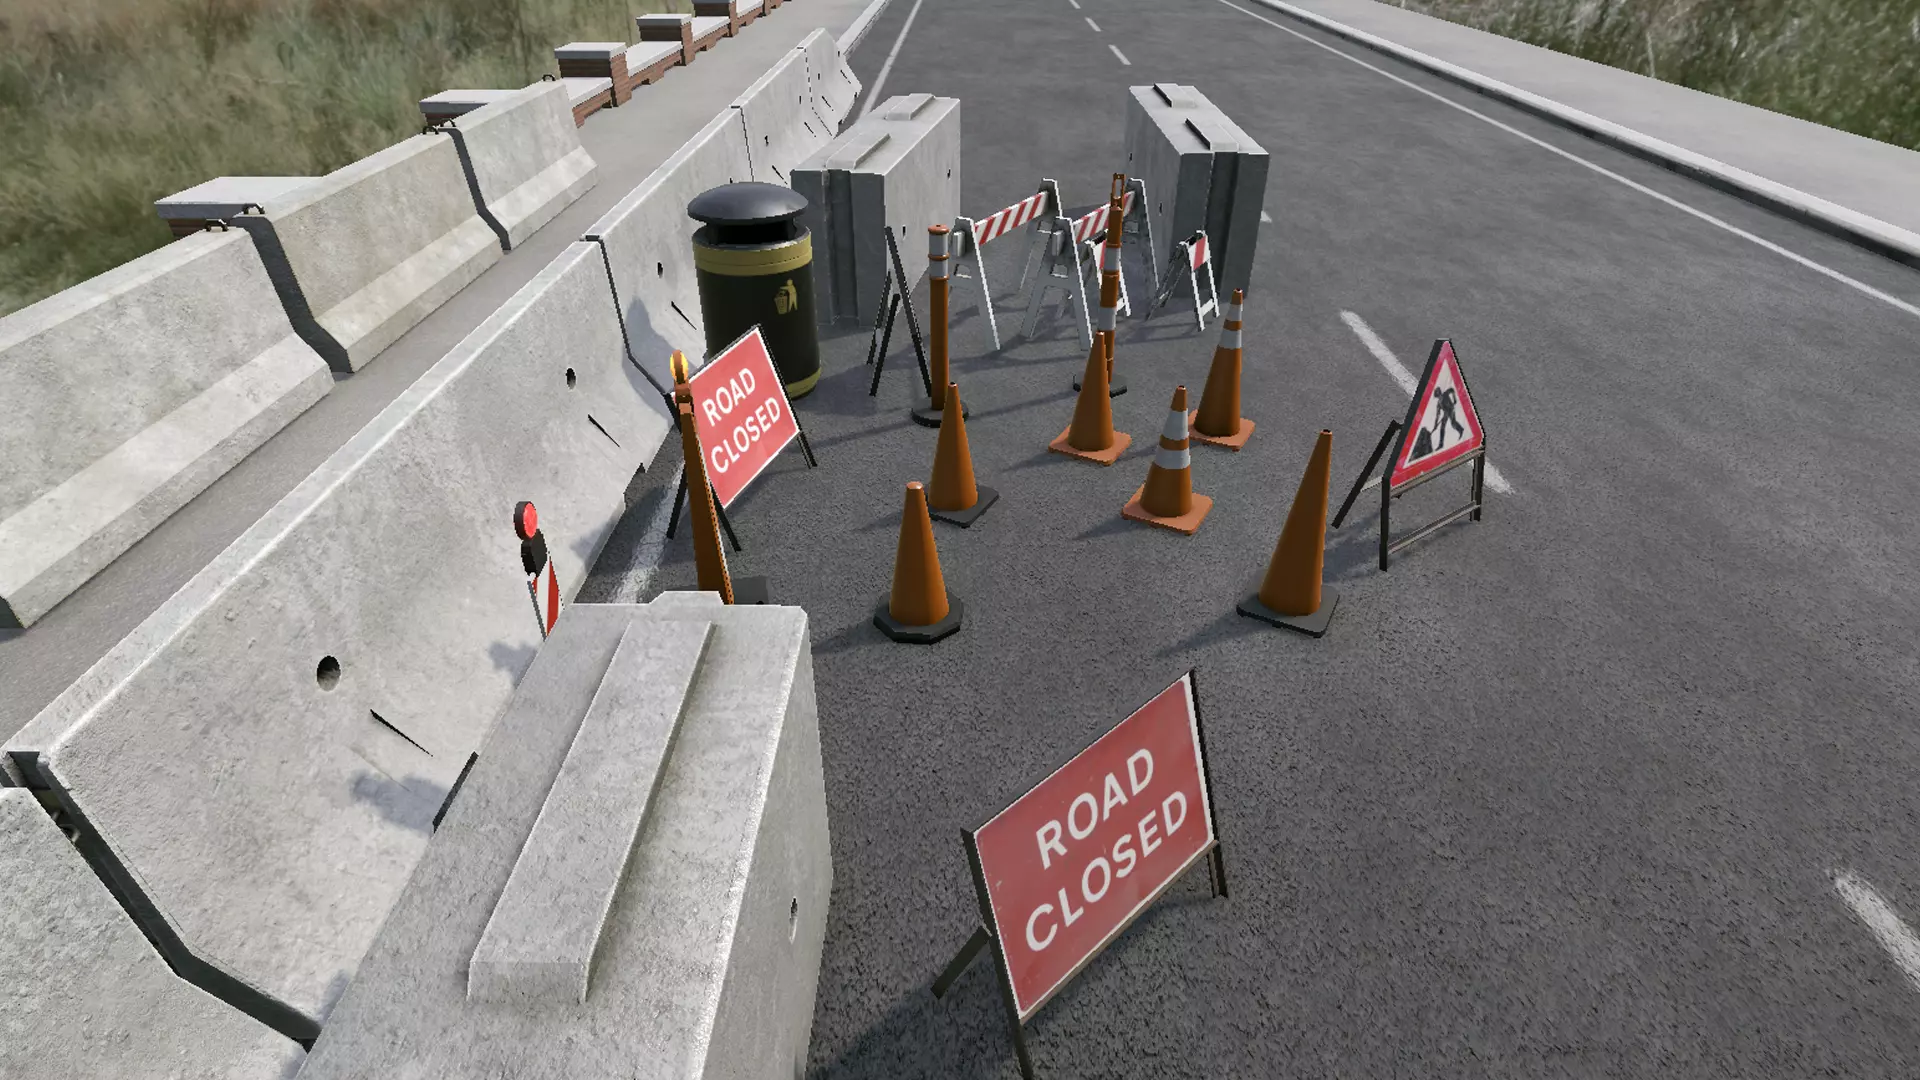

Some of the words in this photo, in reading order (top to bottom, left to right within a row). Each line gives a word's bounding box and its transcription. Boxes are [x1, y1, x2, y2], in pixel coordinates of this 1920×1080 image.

[702, 367, 756, 427] ROAD
[711, 397, 781, 473] CLOSED
[1035, 748, 1154, 870] ROAD
[1025, 791, 1188, 952] CLOSED
